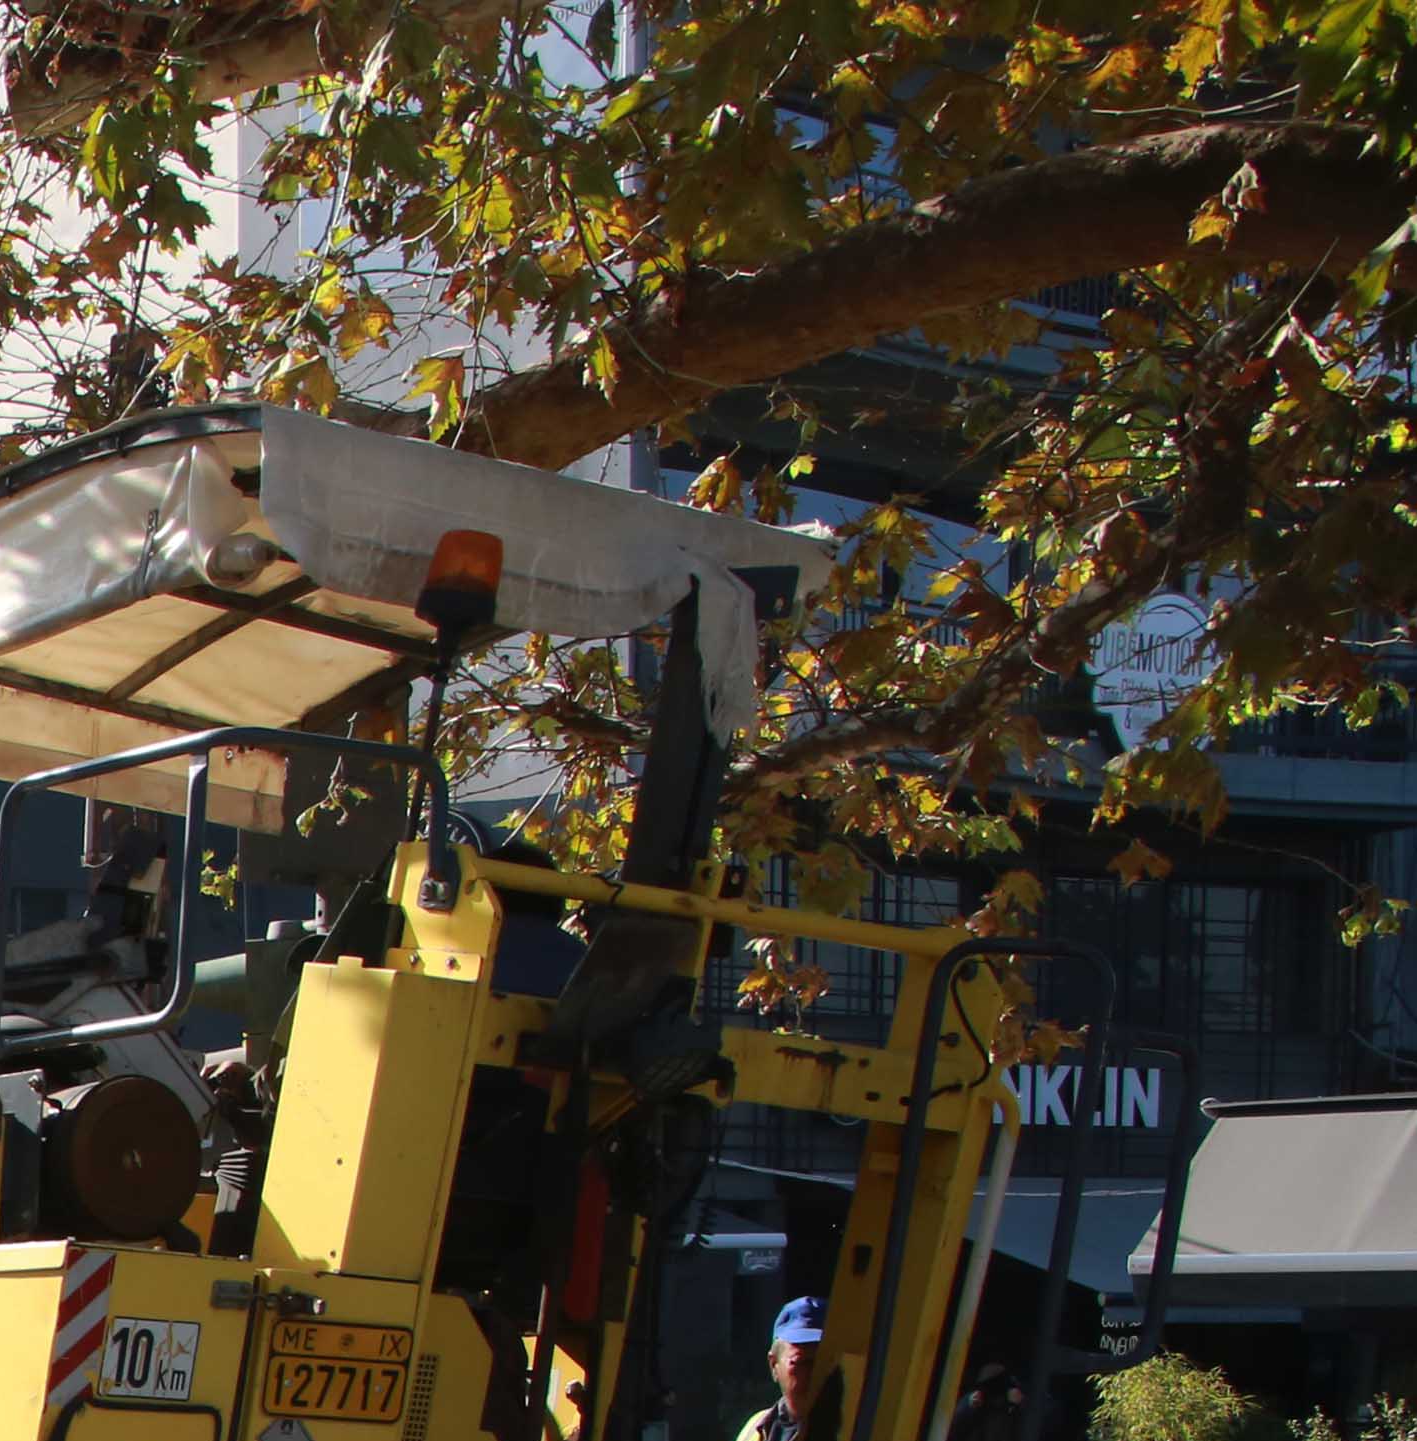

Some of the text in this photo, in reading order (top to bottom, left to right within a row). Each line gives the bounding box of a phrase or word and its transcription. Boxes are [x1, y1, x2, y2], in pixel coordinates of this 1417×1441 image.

[993, 1064, 1161, 1128] NKIN
[112, 1327, 186, 1391] 10 km
[274, 1362, 400, 1413] 127717
